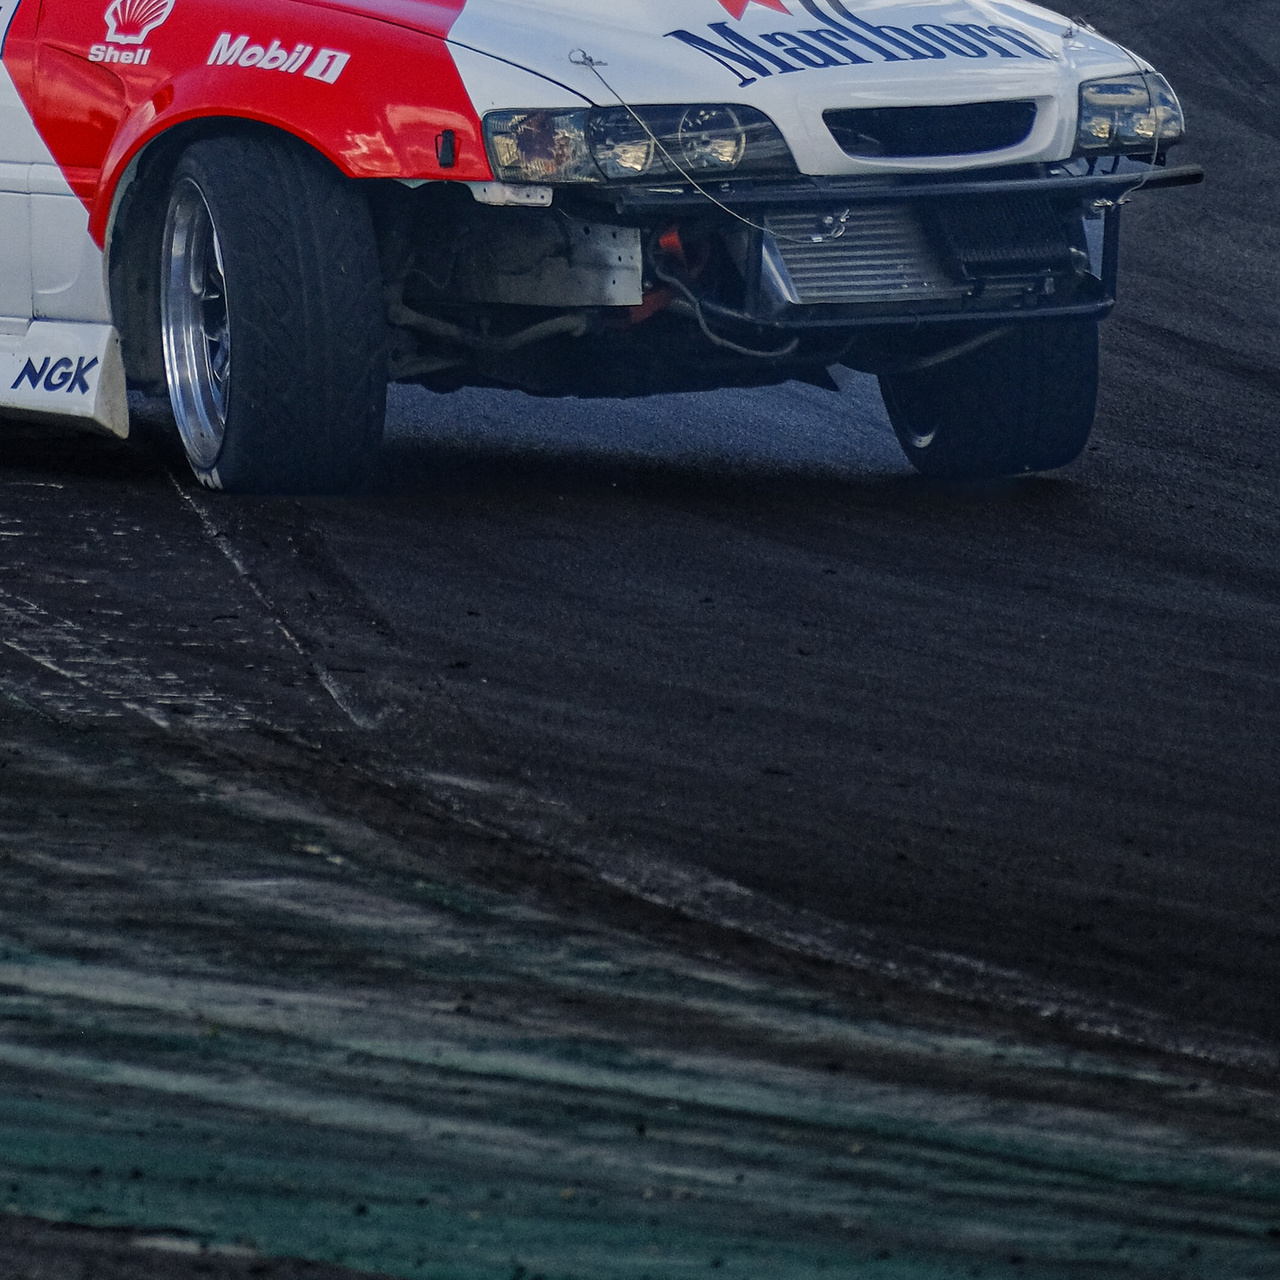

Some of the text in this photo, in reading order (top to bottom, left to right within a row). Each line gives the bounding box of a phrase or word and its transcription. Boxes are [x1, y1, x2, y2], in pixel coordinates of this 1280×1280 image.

[88, 44, 151, 65] Shell
[207, 33, 313, 73] Mobil
[11, 355, 99, 395] NGK
